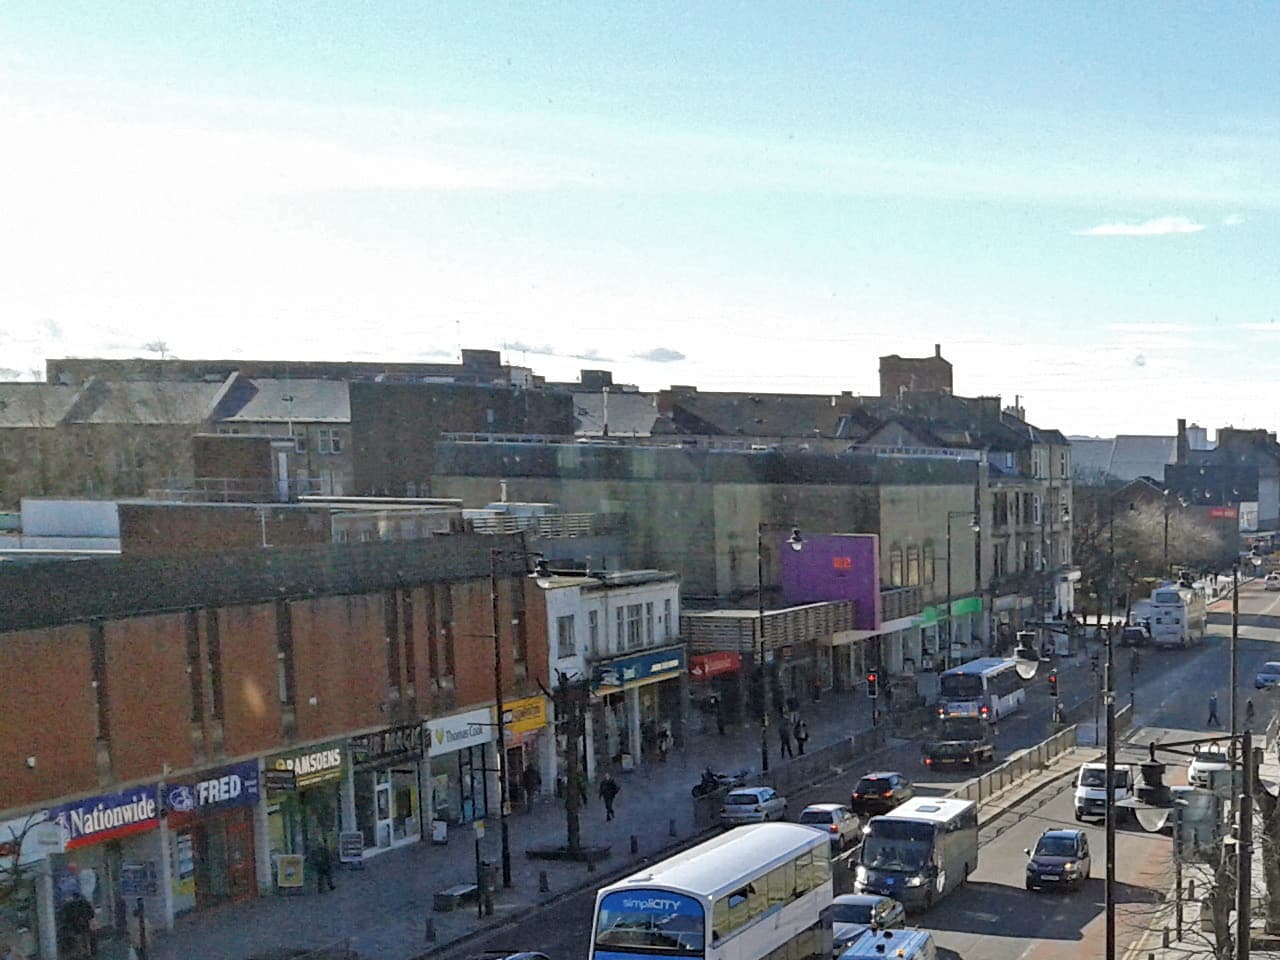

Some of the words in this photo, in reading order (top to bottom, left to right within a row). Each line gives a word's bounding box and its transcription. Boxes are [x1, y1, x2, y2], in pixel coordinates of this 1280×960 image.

[446, 728, 470, 742] Thomas
[469, 725, 483, 736] Cook
[286, 748, 341, 776] RAMSDENS
[197, 774, 241, 806] FRED
[70, 793, 156, 837] Nationwide
[623, 898, 681, 911] simpliCITY
